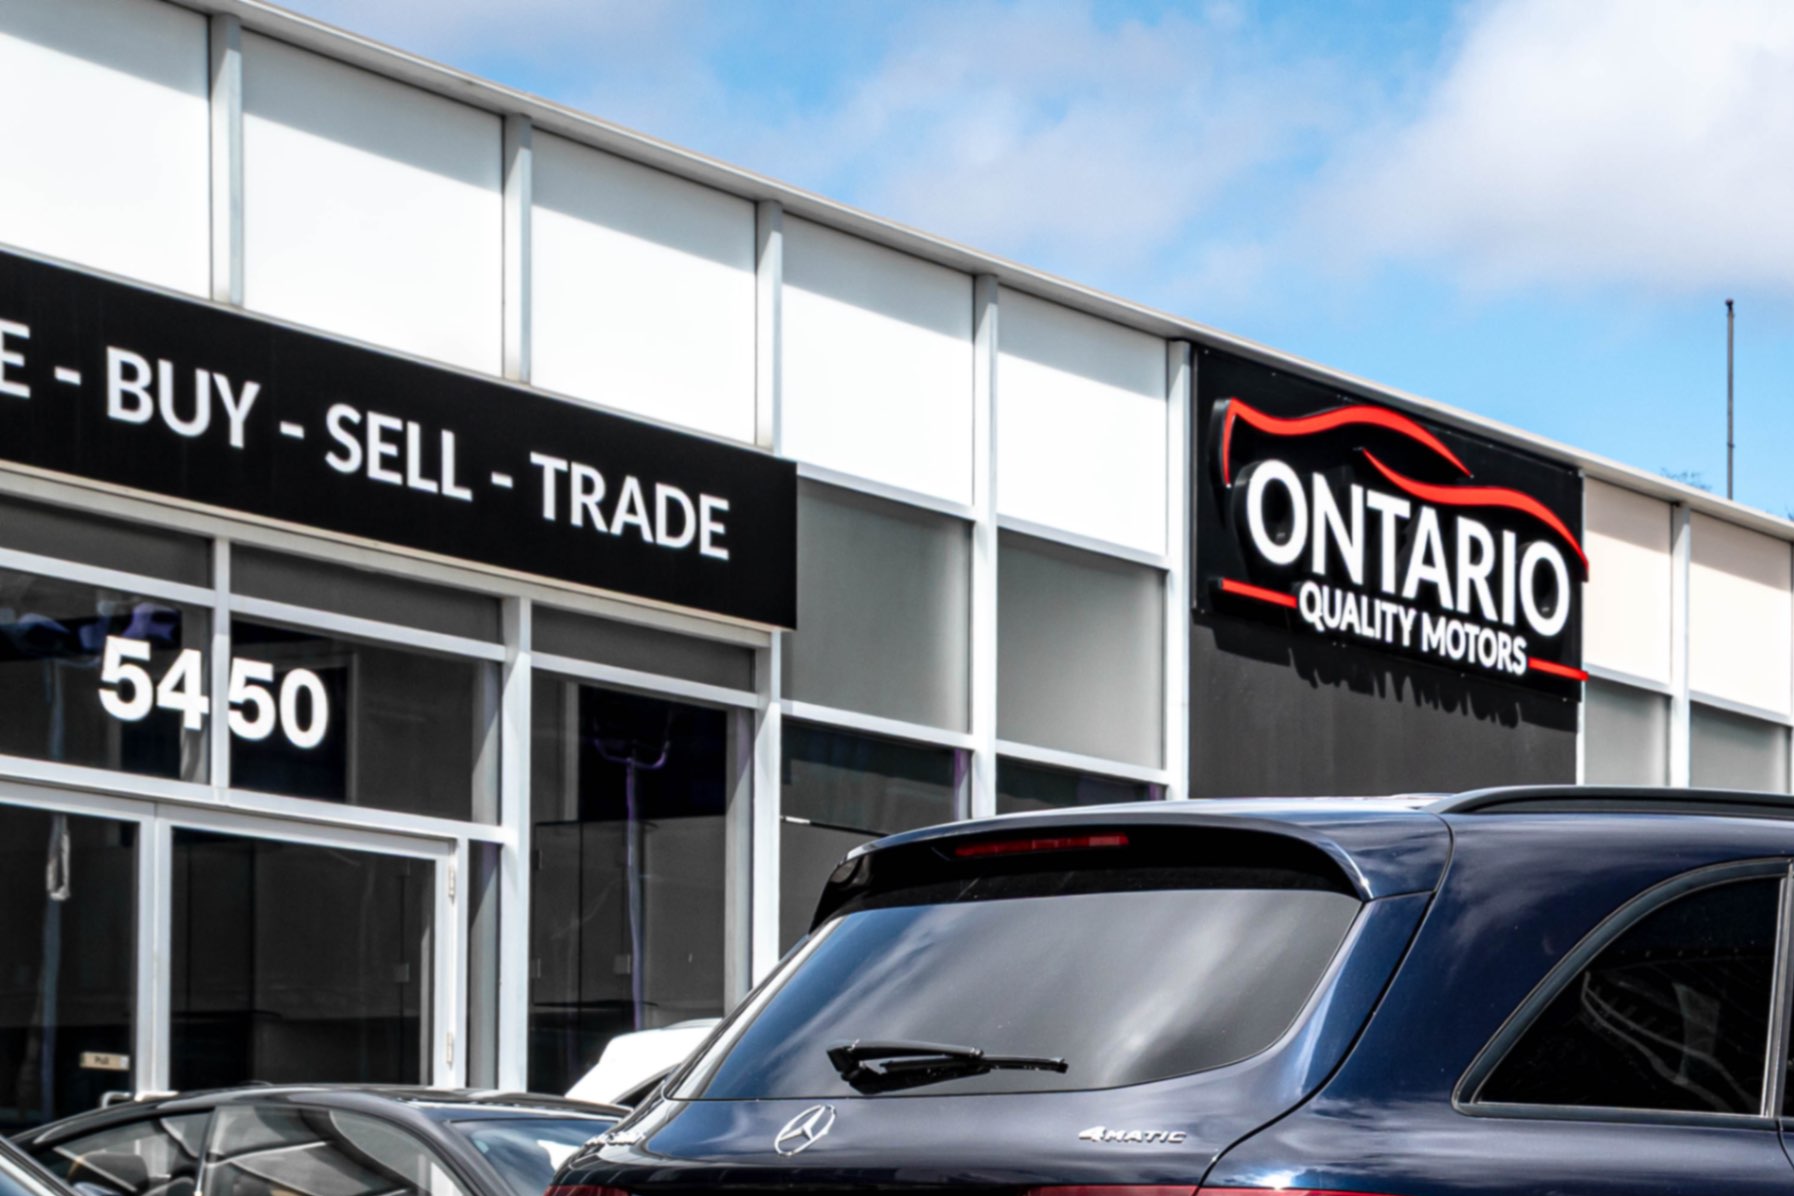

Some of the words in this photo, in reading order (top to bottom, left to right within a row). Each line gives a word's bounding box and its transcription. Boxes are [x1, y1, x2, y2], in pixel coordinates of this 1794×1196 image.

[107, 346, 261, 448] BUY
[325, 403, 473, 501] SELL
[530, 451, 730, 561] TRADE
[1246, 459, 1571, 637] ONTARIO
[1299, 581, 1417, 648] QUALITY
[1421, 612, 1527, 676] MOTORS
[98, 635, 330, 750] 5450
[1077, 1125, 1187, 1144] 4MATIC
